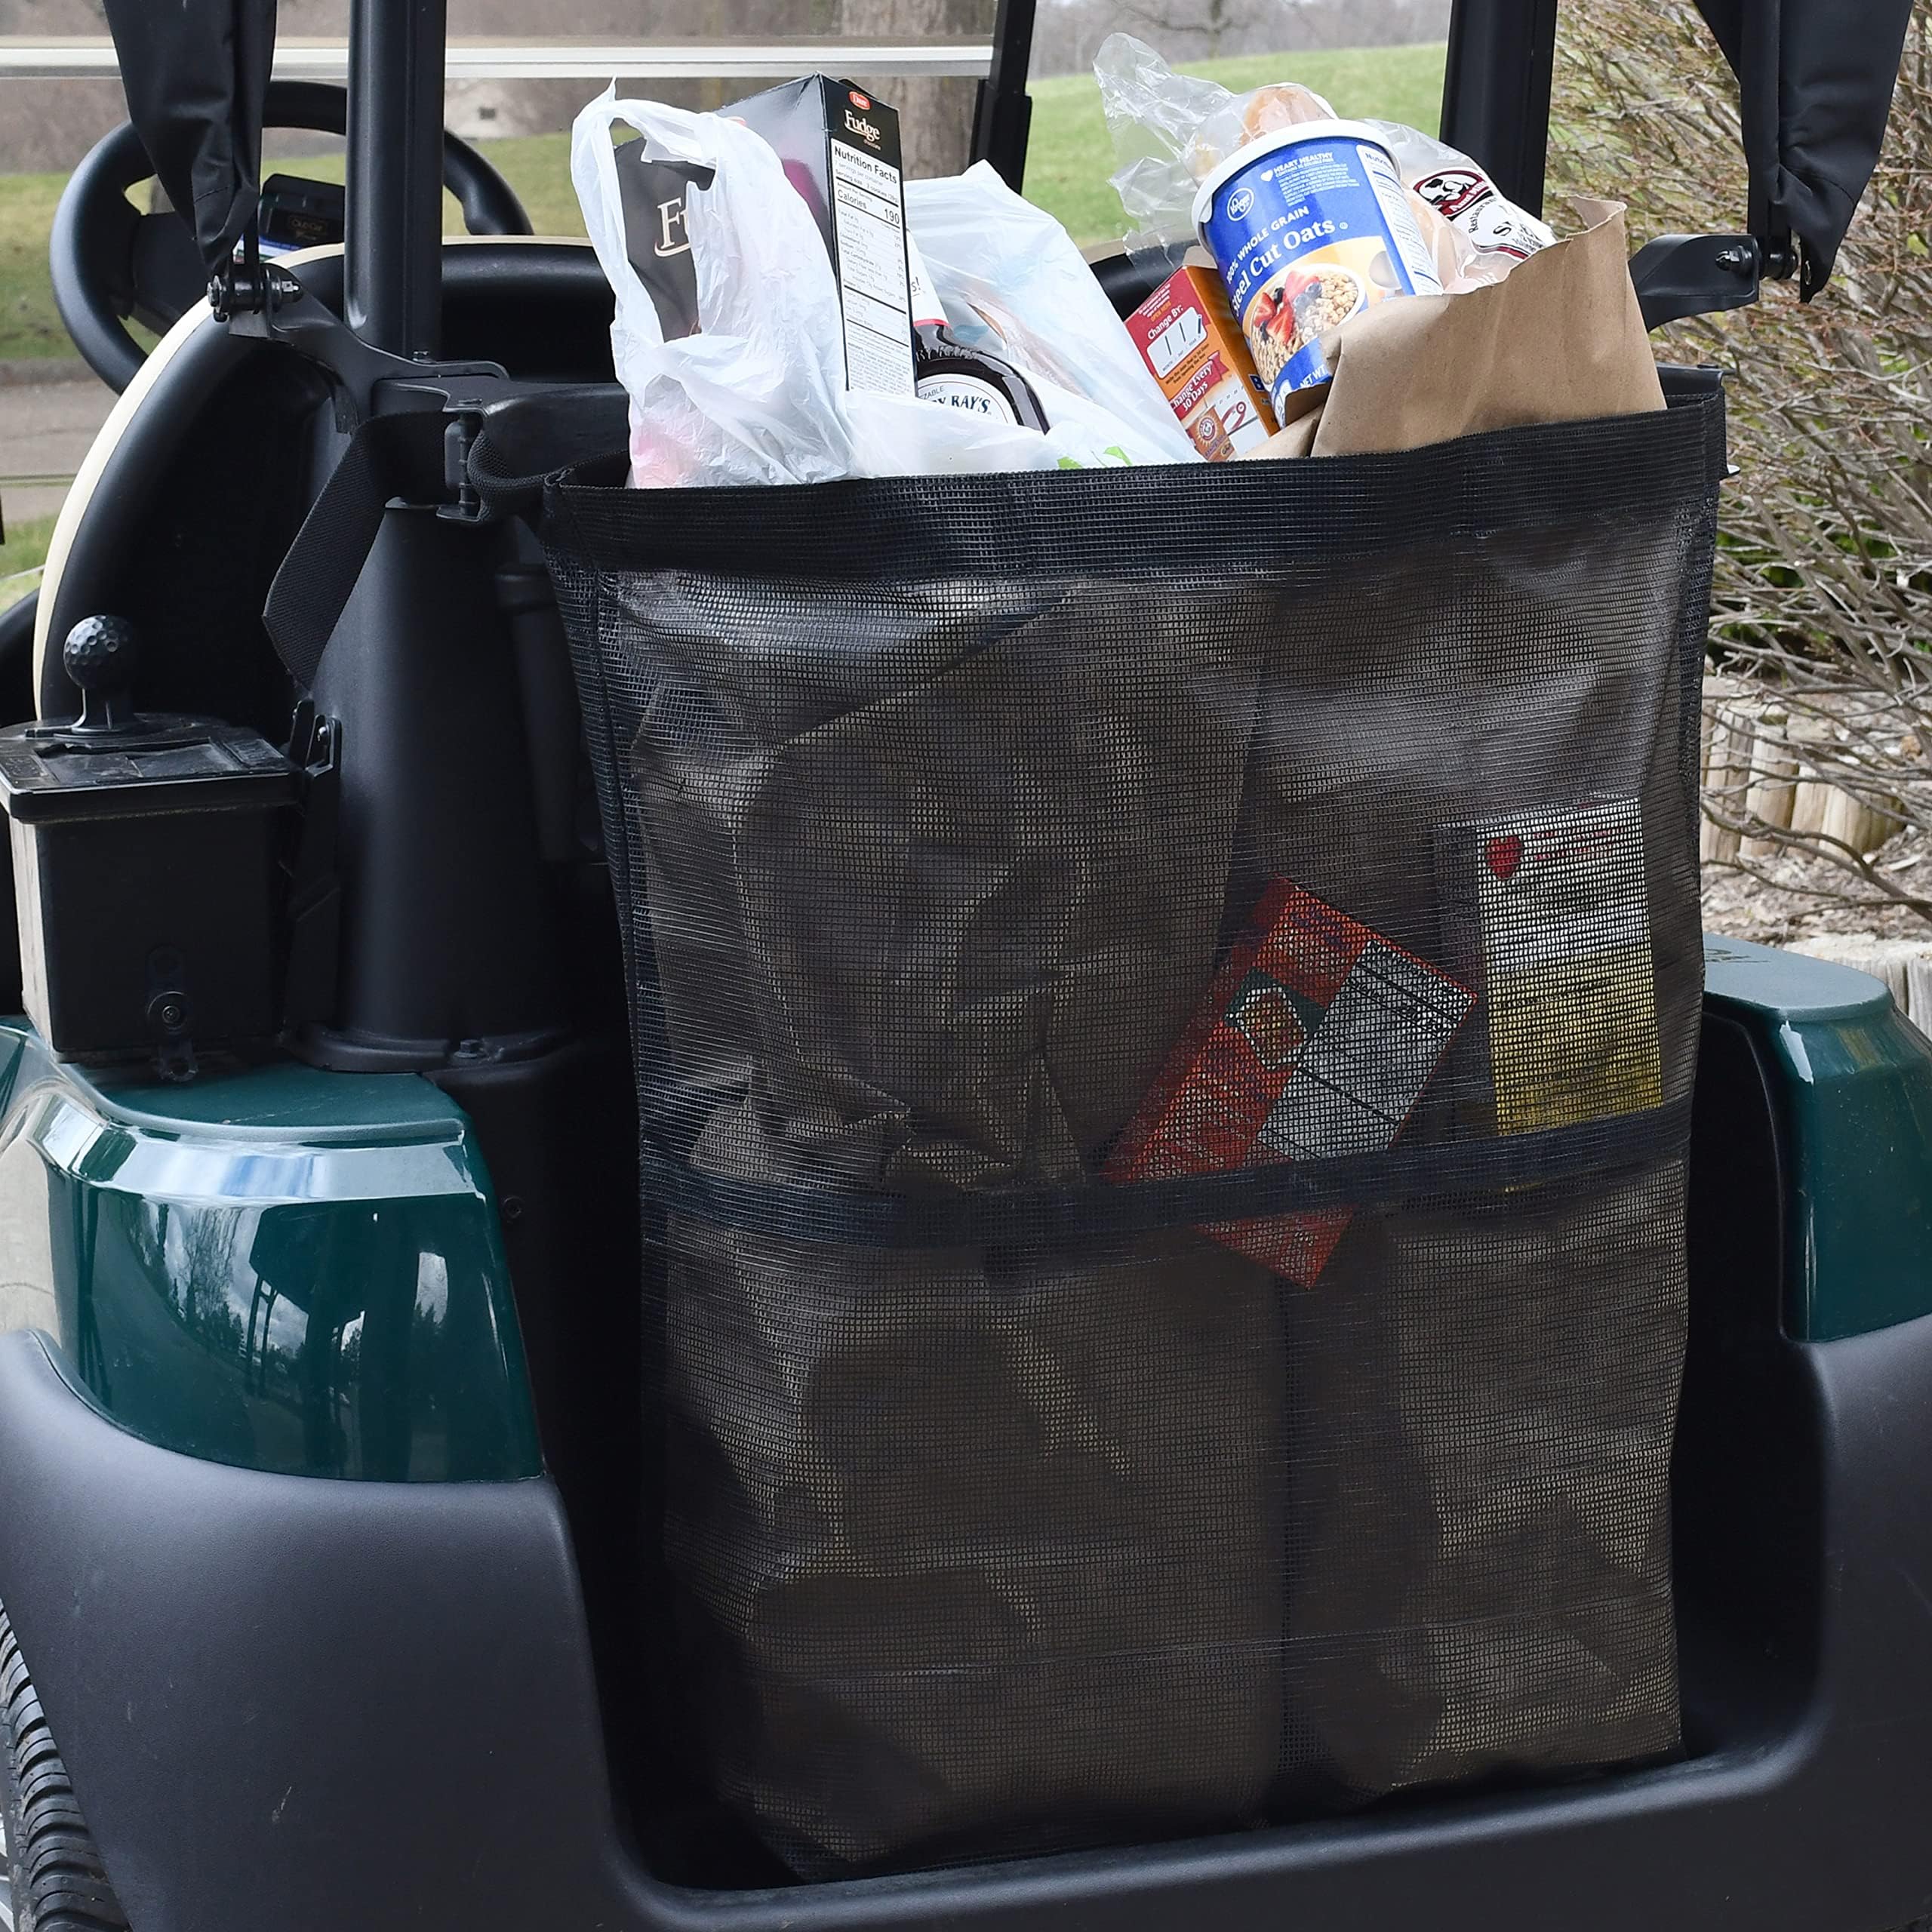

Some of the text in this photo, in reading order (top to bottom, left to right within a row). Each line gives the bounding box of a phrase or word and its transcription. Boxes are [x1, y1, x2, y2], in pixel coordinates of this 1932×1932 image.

[844, 109, 881, 142] Fudge
[835, 145, 872, 172] Nutrition
[874, 165, 897, 184] Facts
[1274, 159, 1298, 174] HEART
[838, 189, 900, 225] Calories 190
[1237, 228, 1269, 261] WHOLE
[1270, 205, 1309, 232] GRAIN
[1250, 243, 1282, 277] Cut
[1283, 220, 1336, 251] Oats
[1148, 315, 1172, 340] Change
[1191, 363, 1214, 386] Every
[952, 395, 991, 414] RAY'S
[1181, 399, 1192, 412] 30
[1190, 380, 1209, 401] Days
